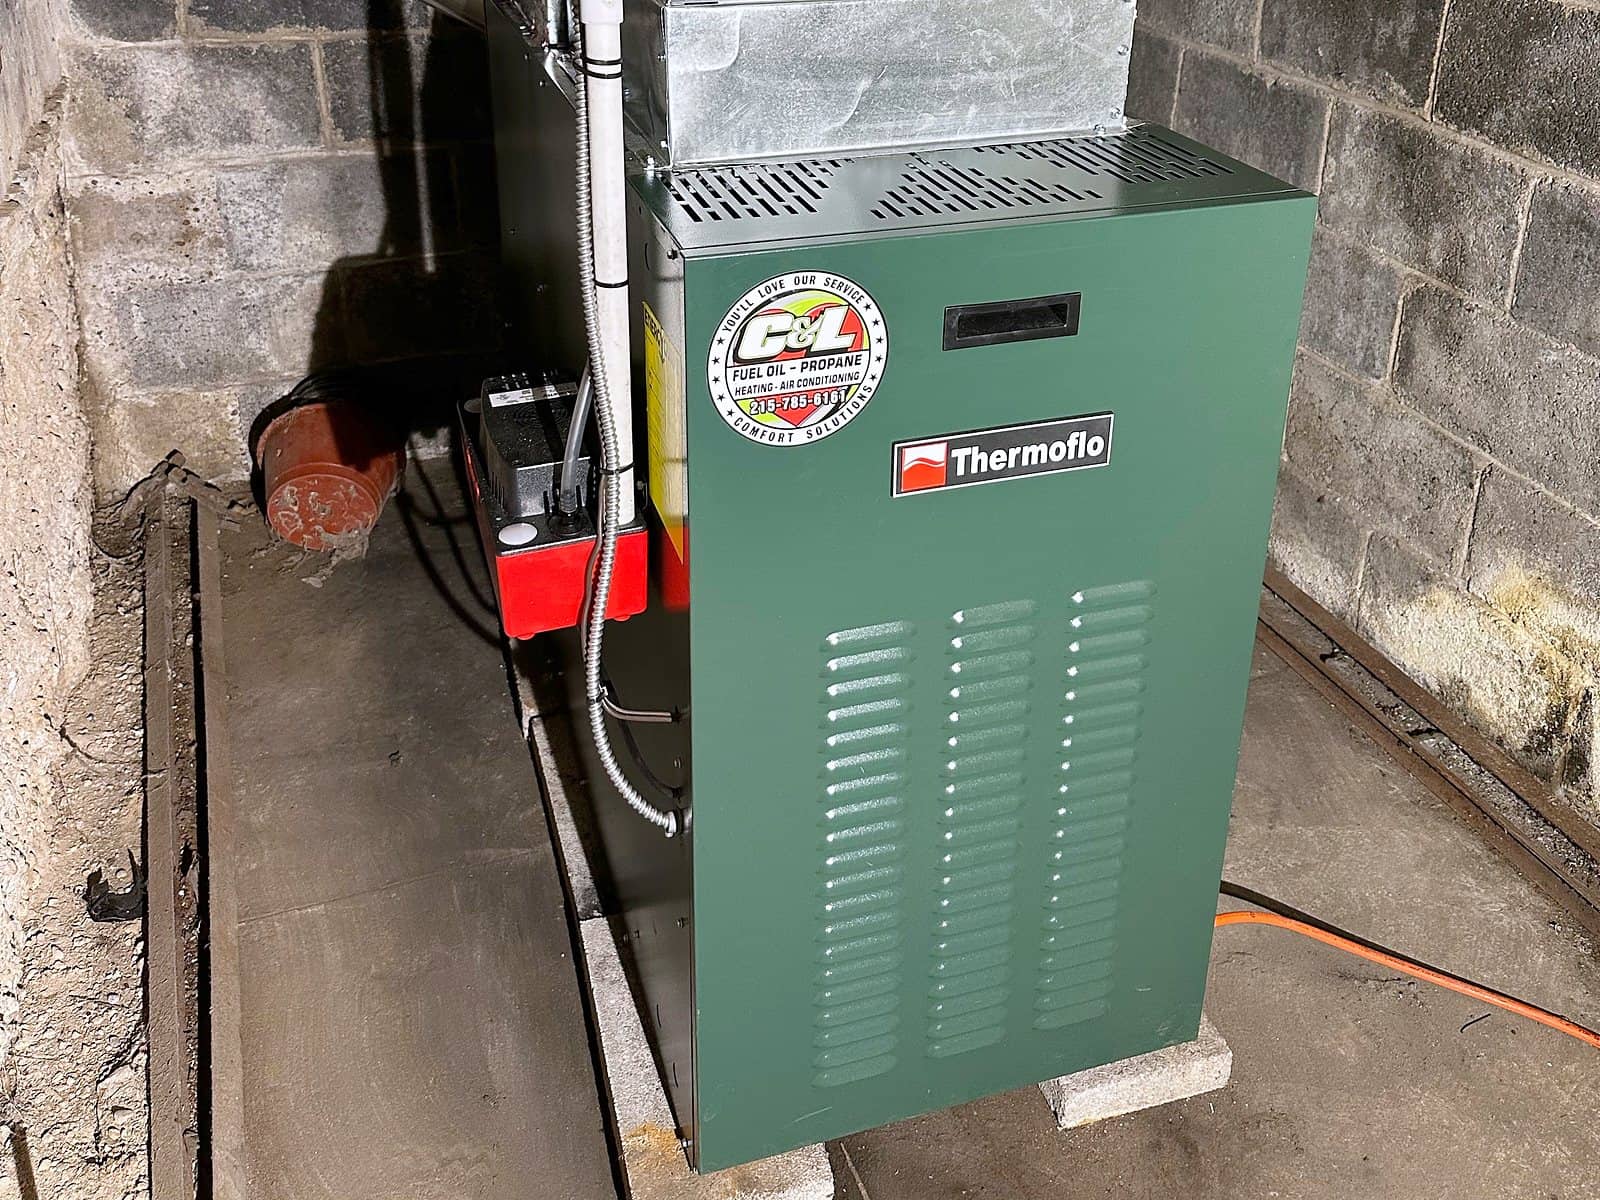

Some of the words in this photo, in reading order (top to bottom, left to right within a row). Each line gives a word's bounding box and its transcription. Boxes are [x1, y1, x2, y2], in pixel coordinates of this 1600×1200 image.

[722, 299, 754, 332] YOU'LL
[758, 279, 785, 298] LOVE
[794, 275, 816, 285] OUR
[824, 277, 865, 304] SERVICE
[733, 305, 857, 363] C&L
[733, 367, 763, 382] FUEL
[767, 364, 786, 377] OIL
[800, 354, 862, 373] PROPANE
[735, 381, 773, 396] HEATING
[780, 379, 795, 390] AIR
[797, 371, 860, 388] CONDITIONING
[734, 417, 794, 443] COMFORT
[806, 385, 873, 439] SOLUTIONS
[750, 388, 848, 415] 215-785-6161
[951, 431, 1105, 476] Thermoflo
